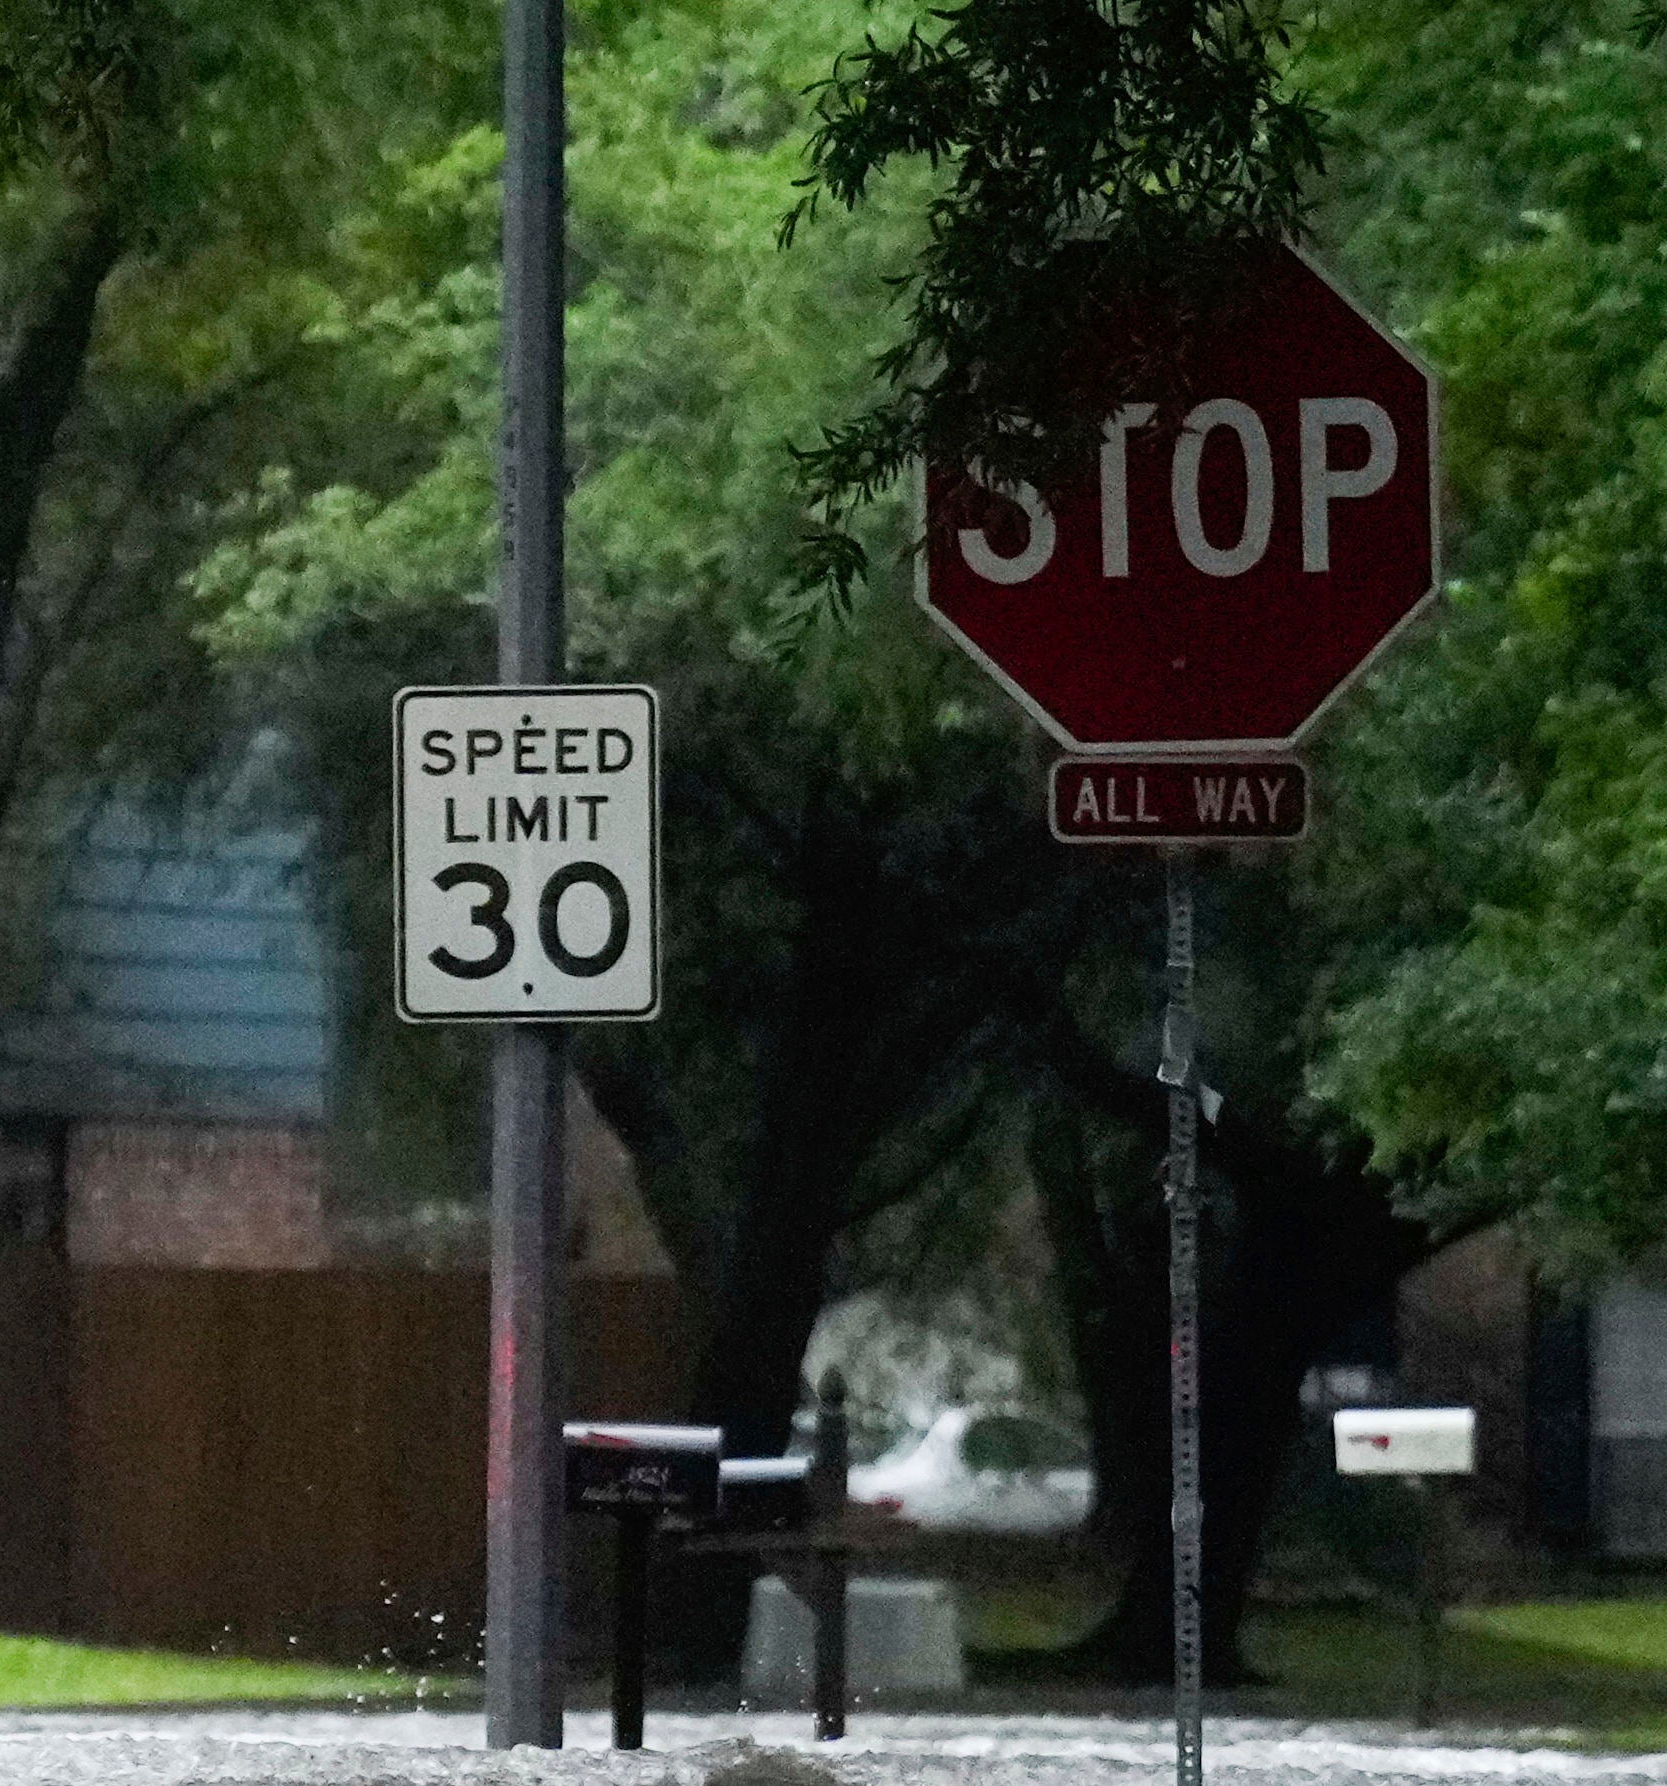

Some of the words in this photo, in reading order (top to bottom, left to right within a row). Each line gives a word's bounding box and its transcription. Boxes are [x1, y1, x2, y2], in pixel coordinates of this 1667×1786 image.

[959, 397, 1400, 584] STOP
[421, 728, 634, 776] SPEED
[444, 796, 609, 843] LIMIT
[1073, 777, 1159, 824] ALL
[1195, 777, 1287, 823] WAY
[428, 861, 630, 979] 30
